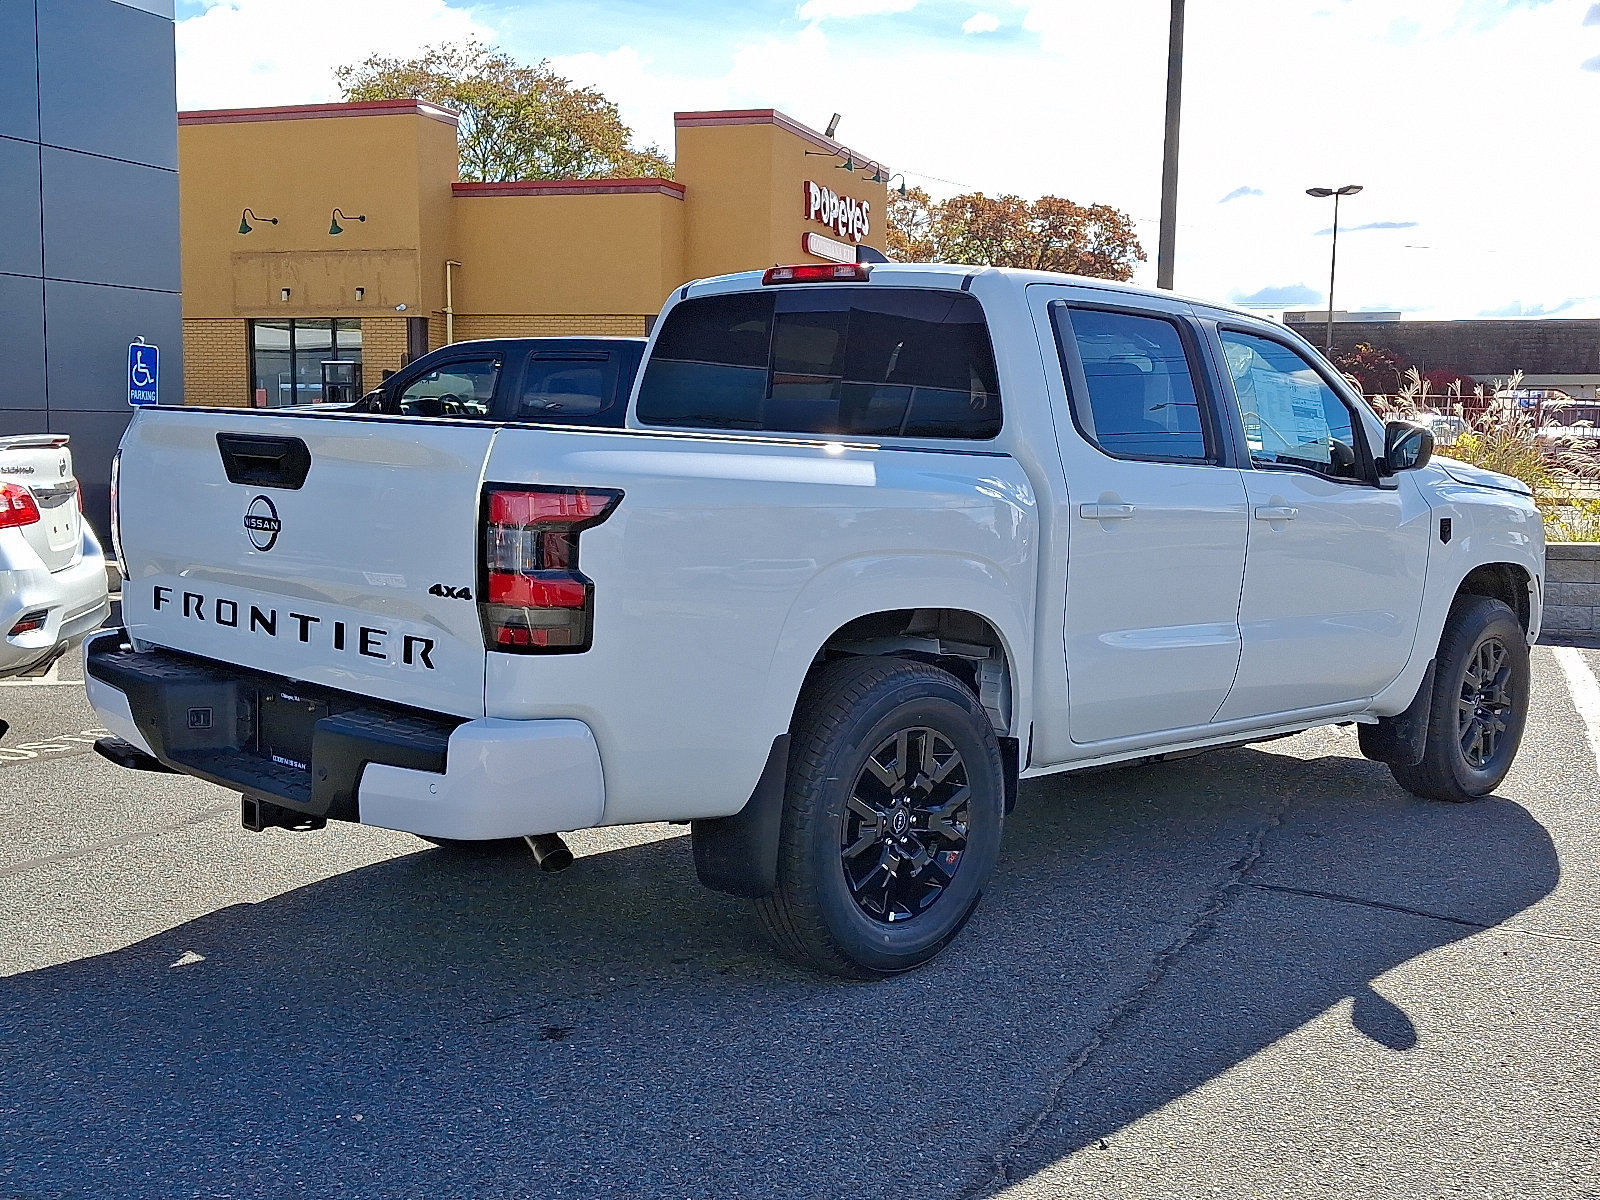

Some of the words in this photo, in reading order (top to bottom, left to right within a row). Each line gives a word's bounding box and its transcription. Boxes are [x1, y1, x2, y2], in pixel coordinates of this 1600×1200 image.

[130, 390, 156, 401] PARKING
[244, 517, 279, 530] NISSAN
[152, 585, 436, 670] FRONTIER
